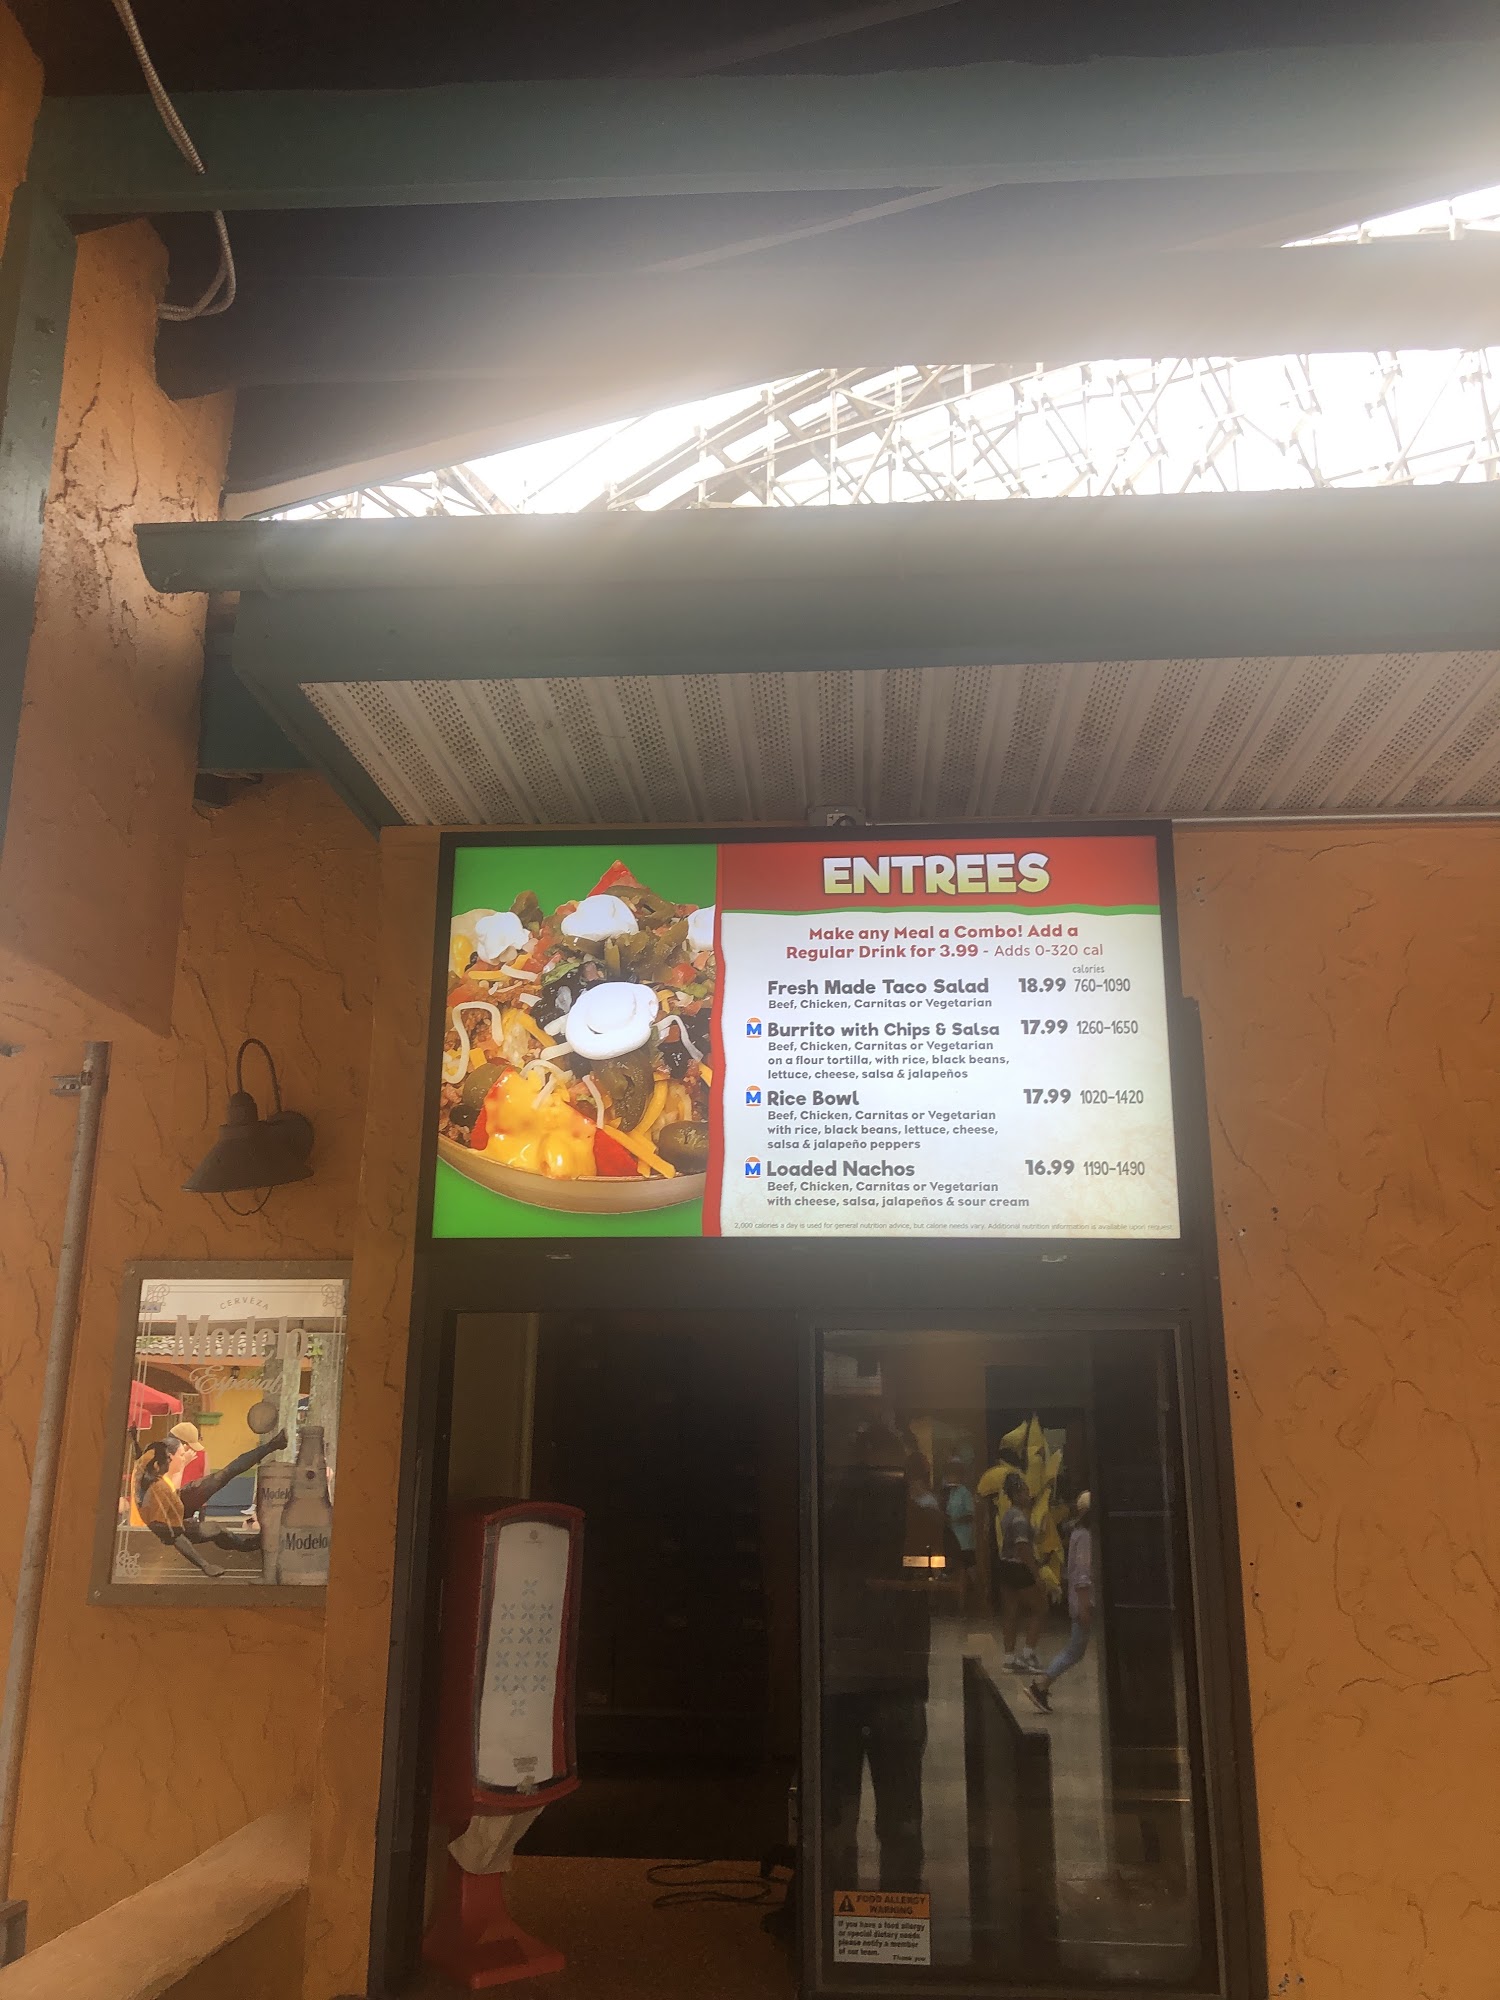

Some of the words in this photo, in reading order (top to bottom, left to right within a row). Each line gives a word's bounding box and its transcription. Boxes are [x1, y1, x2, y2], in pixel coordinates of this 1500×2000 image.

[822, 853, 1050, 895] ENTREES
[809, 926, 855, 941] Make
[858, 929, 890, 943] any
[894, 925, 935, 940] Meal
[938, 928, 950, 939] a
[953, 924, 1023, 939] Combo!
[1026, 923, 1063, 938] Add
[1067, 926, 1079, 938] a
[786, 945, 855, 962] Regular
[859, 944, 907, 959] Drink
[909, 944, 937, 958] for
[939, 943, 979, 958] 3.99
[993, 944, 1031, 957] Adds
[1034, 944, 1079, 957] 0-320
[1082, 943, 1104, 956] cal
[1072, 963, 1106, 974] calories
[767, 979, 819, 996] Fresh
[824, 978, 877, 995] Made
[881, 978, 928, 994] Taco
[933, 977, 989, 994] Salad
[1017, 977, 1067, 993] 18.99
[1074, 977, 1131, 993] 760-1090
[768, 999, 798, 1010] Beef,
[799, 999, 851, 1010] Chicken,
[853, 998, 907, 1009] Carnitas
[909, 1000, 923, 1008] or
[924, 997, 993, 1010] Vegetarian
[767, 1021, 836, 1038] Burrito
[840, 1022, 879, 1037] with
[883, 1021, 931, 1040] Chips
[935, 1022, 947, 1036] &
[951, 1022, 1000, 1036] Salsa
[1020, 1019, 1069, 1035] 17.99
[1076, 1019, 1139, 1035] 1260-1650
[768, 1041, 798, 1052] Beef,
[799, 1041, 852, 1052] Chicken,
[854, 1040, 908, 1051] Carnitas
[909, 1042, 924, 1051] or
[926, 1040, 994, 1053] Vegetarian
[767, 1057, 783, 1066] on
[785, 1057, 793, 1065] a
[795, 1055, 825, 1065] flour
[826, 1054, 873, 1066] tortilla,
[874, 1054, 899, 1065] with
[902, 1054, 929, 1066] rice,
[931, 1054, 963, 1064] black
[968, 1054, 1010, 1065] beans,
[767, 1069, 812, 1080] lettuce,
[814, 1069, 859, 1080] cheese,
[861, 1068, 894, 1079] salsa
[896, 1068, 905, 1079] &
[907, 1068, 969, 1081] jalapeños
[767, 1089, 807, 1107] Rice
[812, 1090, 860, 1106] Bowl
[1023, 1088, 1072, 1105] 17.99
[1079, 1089, 1145, 1105] 1020-1420
[767, 1110, 798, 1121] Beef,
[799, 1110, 853, 1121] Chicken,
[854, 1110, 909, 1120] Carnitas
[911, 1112, 926, 1120] or
[927, 1109, 996, 1122] Vegetarian
[766, 1124, 792, 1135] with
[794, 1124, 822, 1136] rice,
[824, 1124, 859, 1135] black
[860, 1124, 902, 1136] beans,
[904, 1124, 950, 1136] lettuce,
[952, 1124, 999, 1136] cheese,
[767, 1139, 800, 1149] salsa
[802, 1139, 811, 1149] &
[812, 1138, 868, 1151] jalapeño
[870, 1141, 921, 1151] peppers
[766, 1159, 837, 1177] Loaded
[842, 1159, 916, 1177] Nachos
[1024, 1159, 1075, 1176] 16.99
[1083, 1160, 1146, 1176] 1190-1490
[767, 1181, 798, 1193] Beef,
[799, 1181, 853, 1193] Chicken,
[855, 1181, 911, 1192] Carnitas
[912, 1183, 928, 1192] or
[928, 1181, 999, 1194] Vegetarian
[766, 1195, 792, 1207] with
[794, 1195, 840, 1207] cheese,
[842, 1195, 880, 1208] salsa,
[881, 1195, 944, 1209] jalapeños
[945, 1196, 955, 1207] &
[957, 1198, 987, 1207] sour
[988, 1198, 1030, 1207] cream
[220, 1297, 269, 1310] CERVEZA
[173, 1314, 308, 1364] Modelo
[189, 1365, 283, 1395] Especial
[286, 1533, 329, 1550] Modelo
